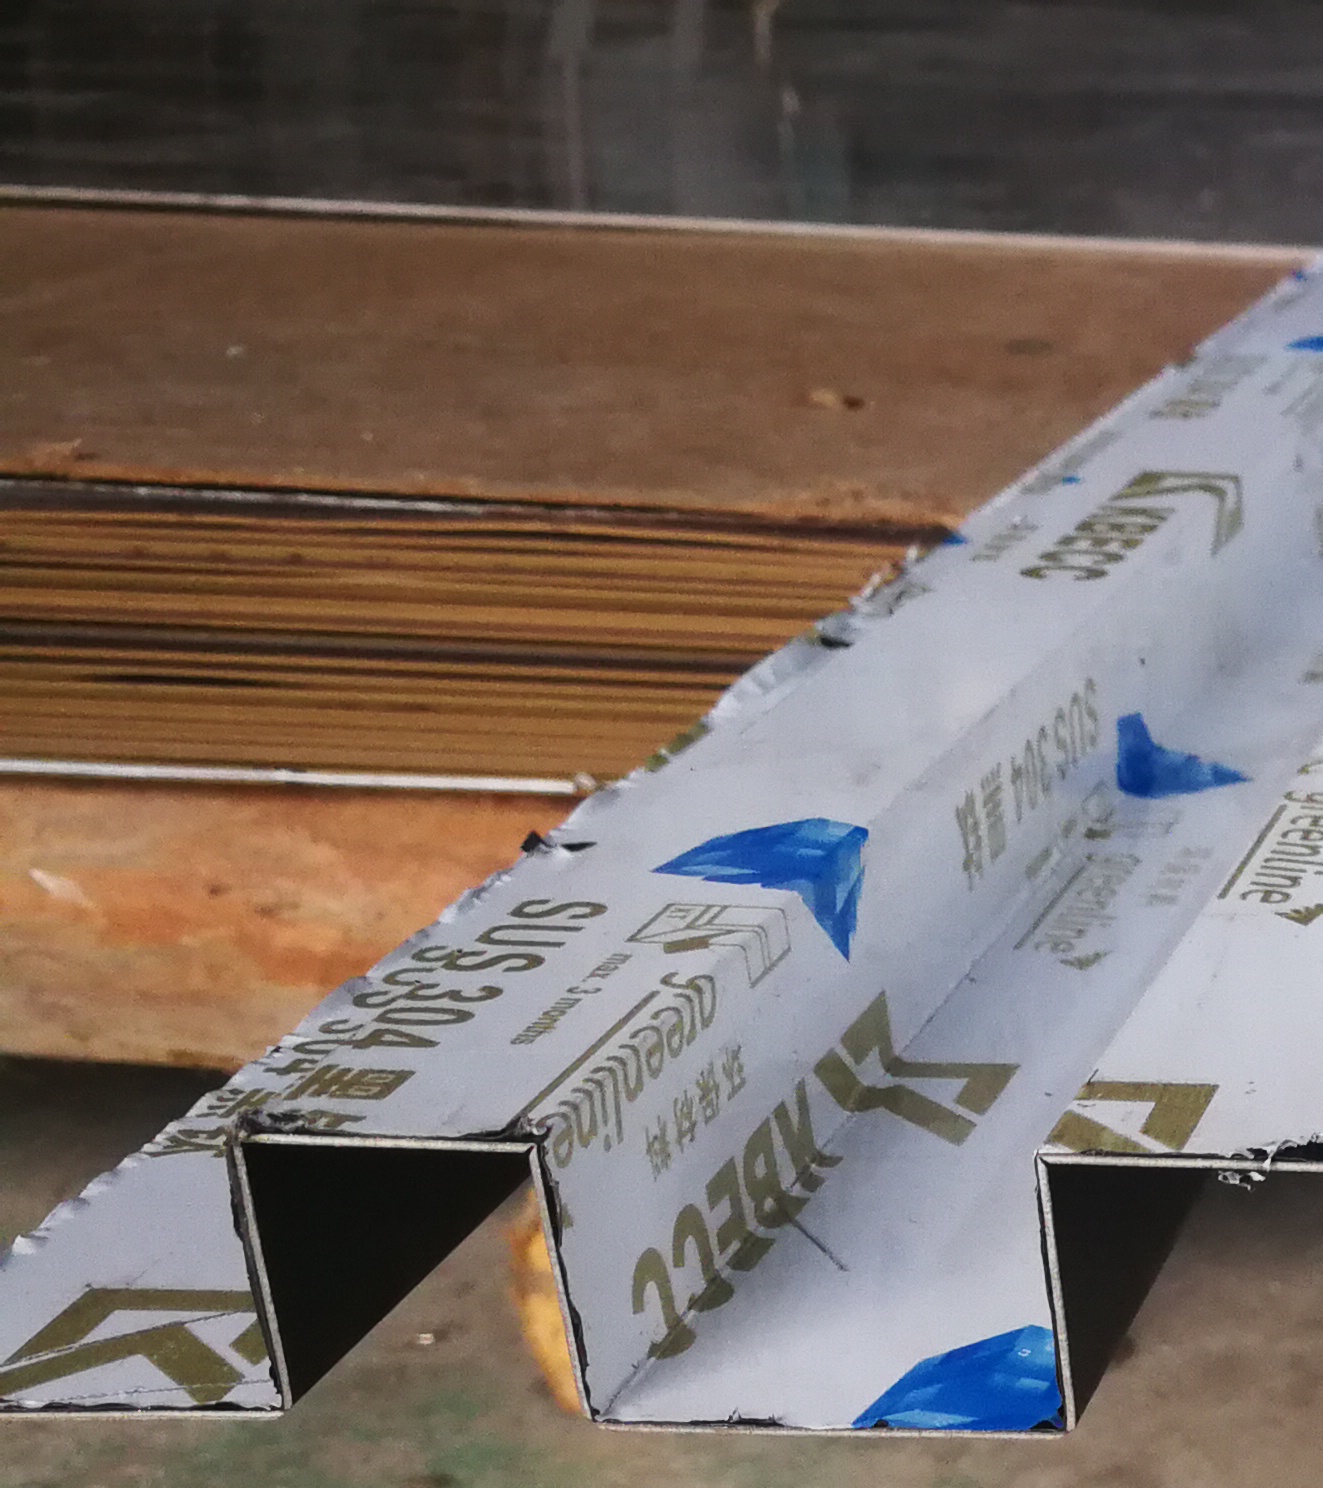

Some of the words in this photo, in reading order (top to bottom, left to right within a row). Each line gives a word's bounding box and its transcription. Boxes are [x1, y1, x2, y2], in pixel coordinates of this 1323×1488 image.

[440, 897, 608, 972] SUS
[349, 984, 504, 1050] 304
[551, 970, 718, 1169] greenline
